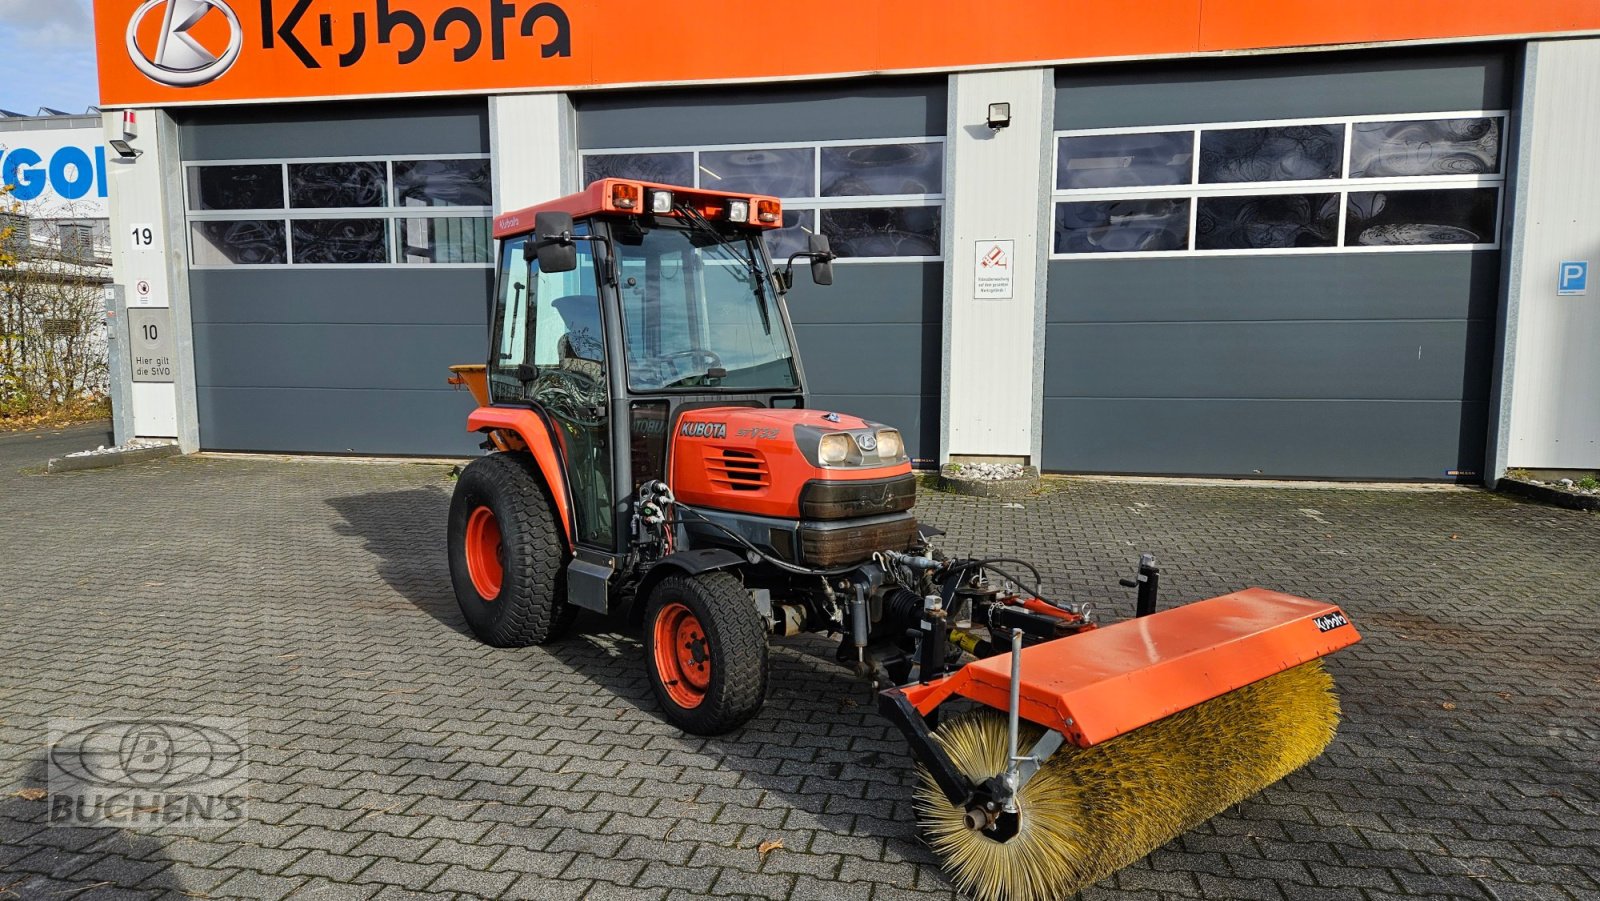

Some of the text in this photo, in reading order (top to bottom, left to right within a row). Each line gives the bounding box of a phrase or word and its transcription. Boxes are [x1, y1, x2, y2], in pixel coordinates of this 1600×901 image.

[260, 0, 571, 68] Kubota
[0, 146, 108, 200] GO
[132, 228, 153, 246] 19
[1564, 265, 1583, 287] P
[142, 324, 158, 341] 10
[136, 356, 169, 367] Hier gilt
[136, 367, 171, 376] die StVO
[680, 422, 727, 439] KUBOTA
[1313, 612, 1347, 631] Kubota
